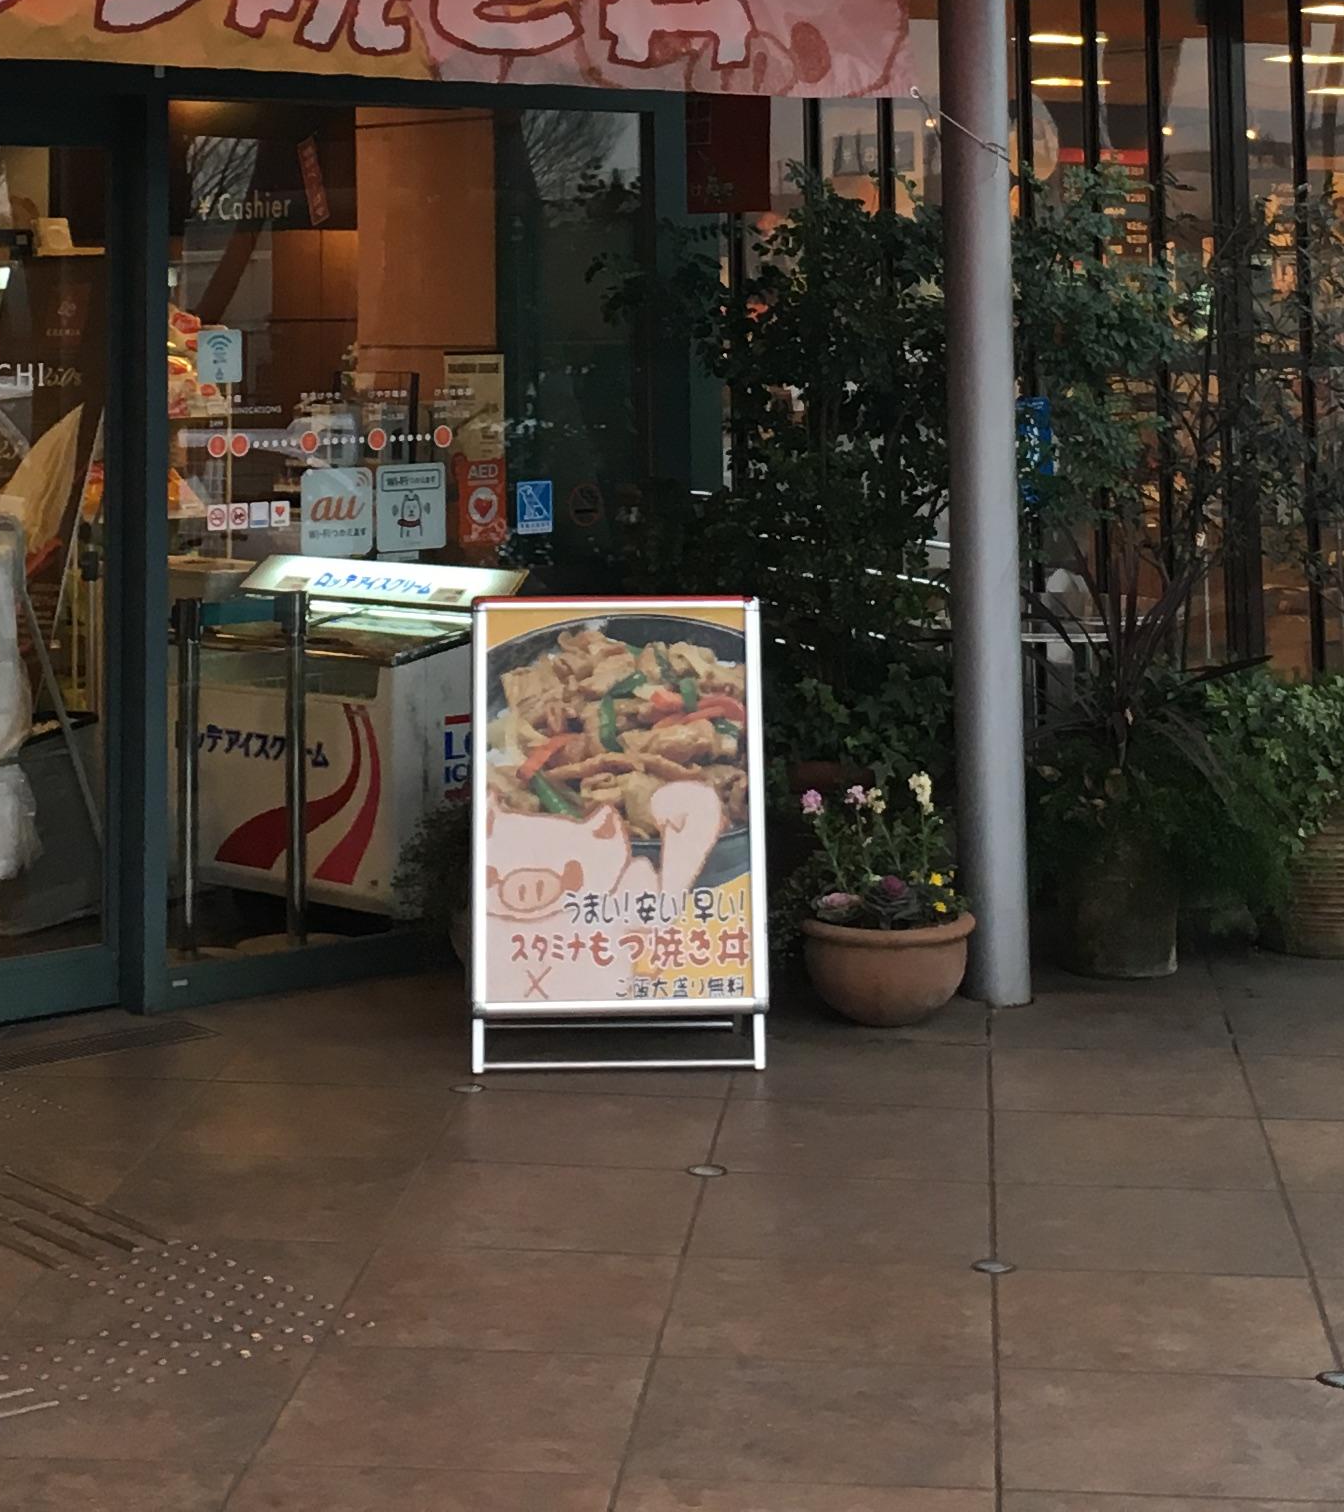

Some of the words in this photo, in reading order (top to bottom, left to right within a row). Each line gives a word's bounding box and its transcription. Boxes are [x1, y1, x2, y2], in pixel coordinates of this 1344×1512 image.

[217, 189, 292, 221] Cashier
[468, 464, 498, 479] AED
[310, 493, 365, 523] au
[313, 571, 433, 595] ロッテアイスクリーム
[511, 926, 749, 967] スタミナもつ焼き丼
